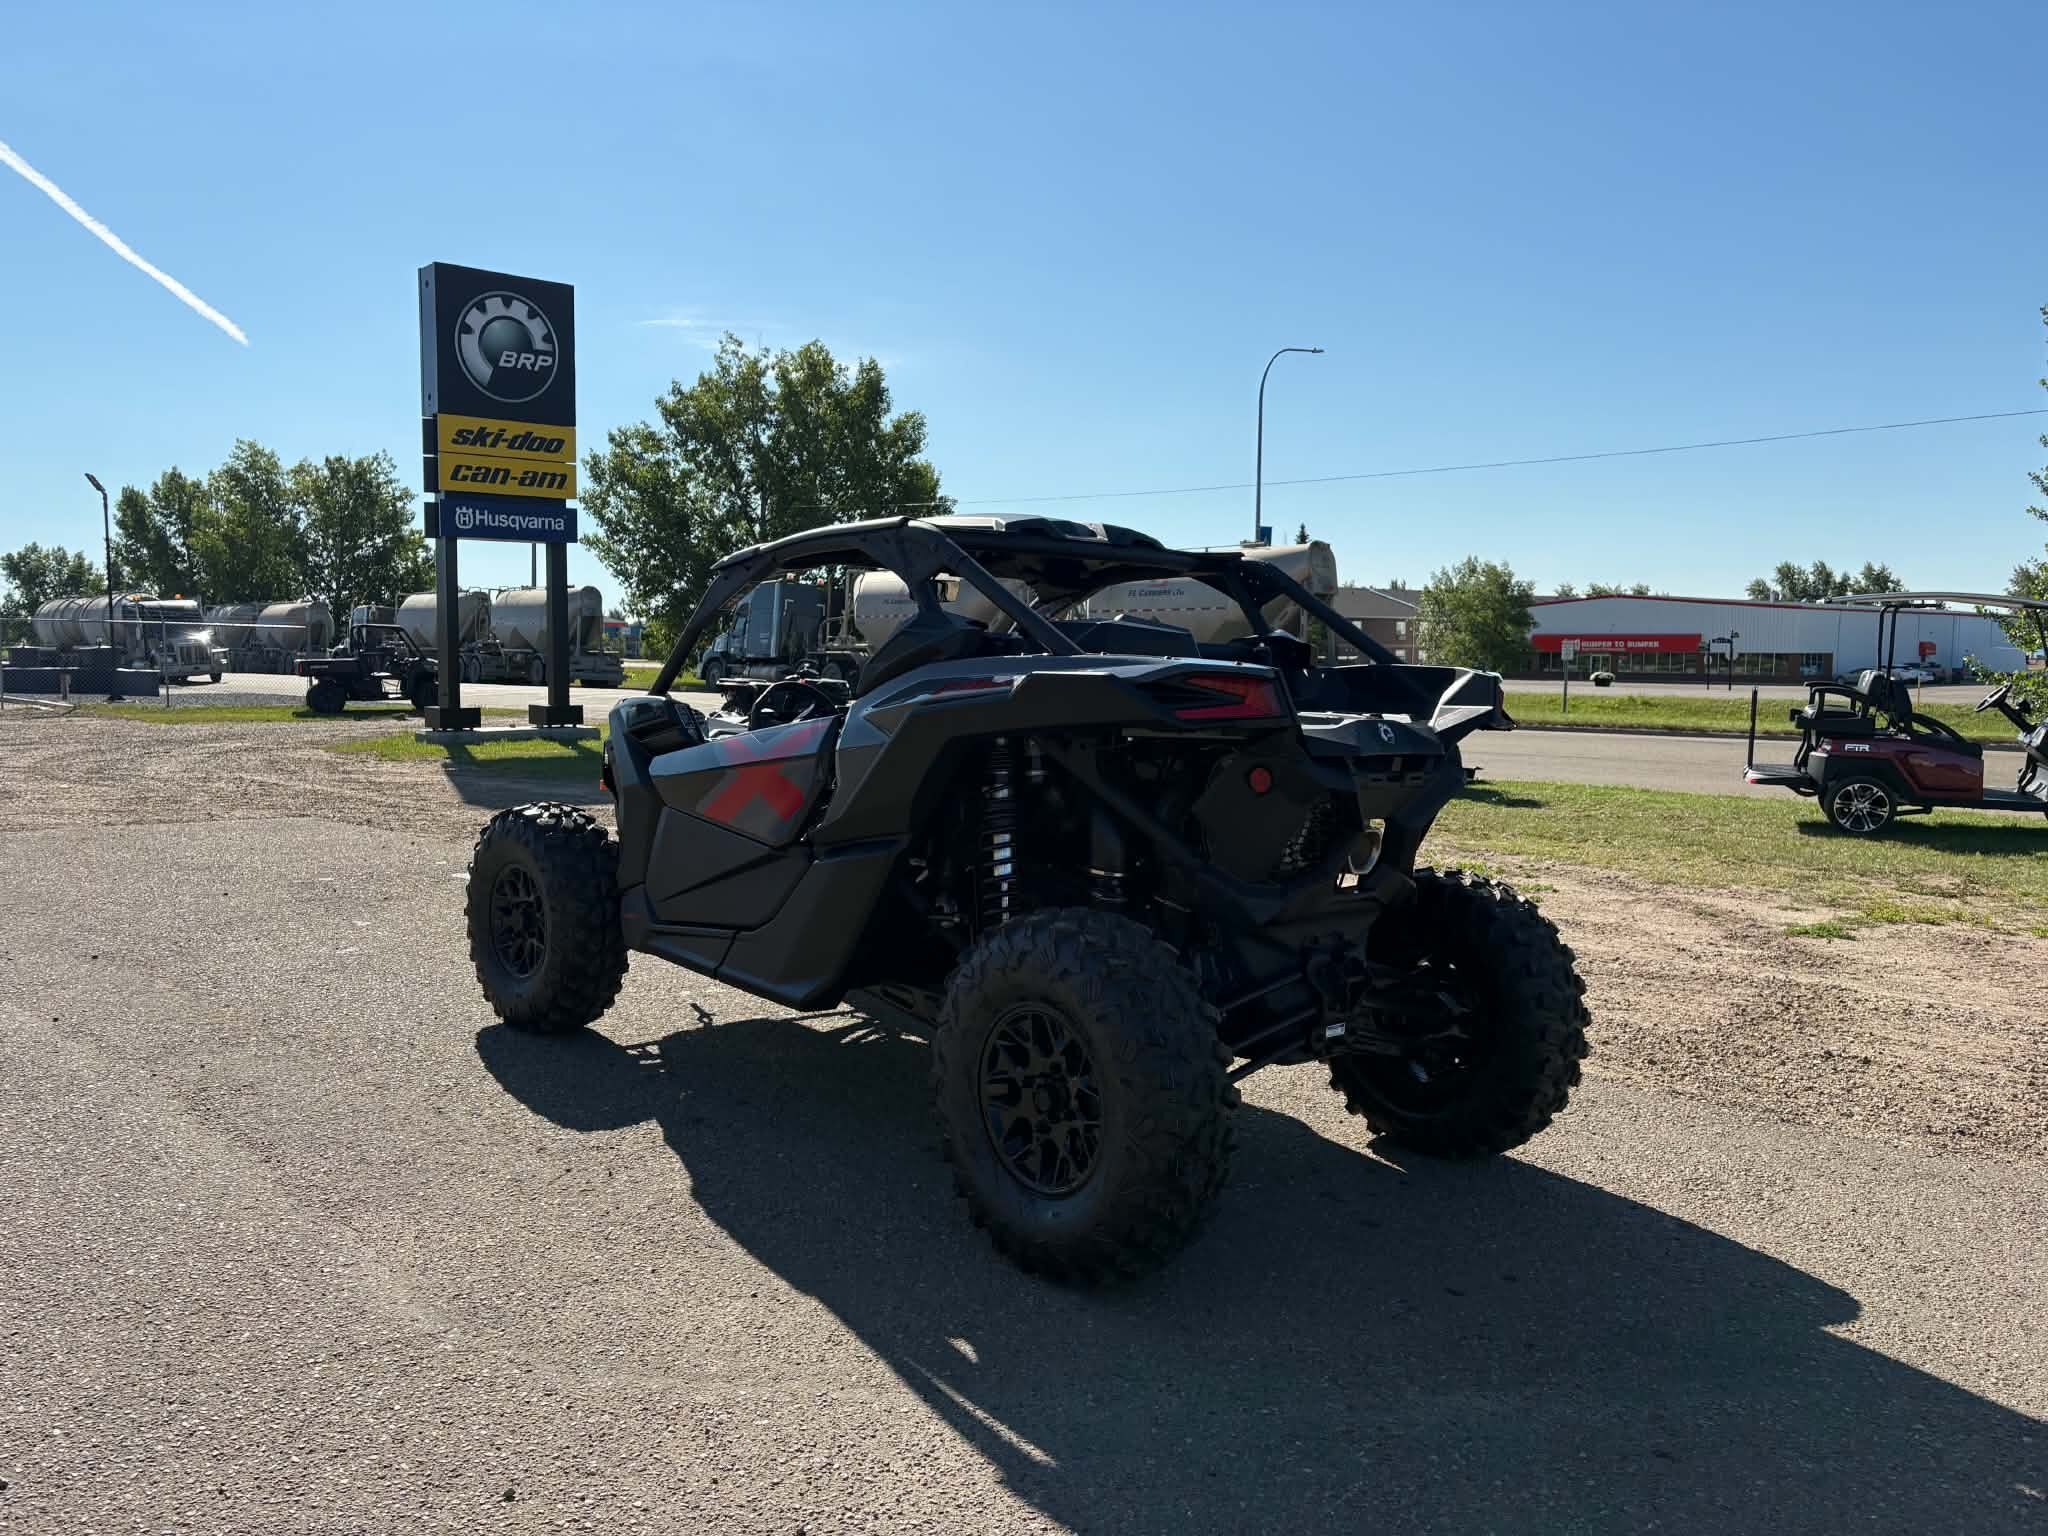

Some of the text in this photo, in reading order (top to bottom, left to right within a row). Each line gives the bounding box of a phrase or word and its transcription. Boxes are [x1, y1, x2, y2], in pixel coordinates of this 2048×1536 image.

[498, 350, 553, 373] BRP
[451, 426, 566, 454] ski-doo
[449, 463, 568, 490] can-am
[475, 509, 565, 531] Husqvarna
[1614, 640, 1625, 648] TO
